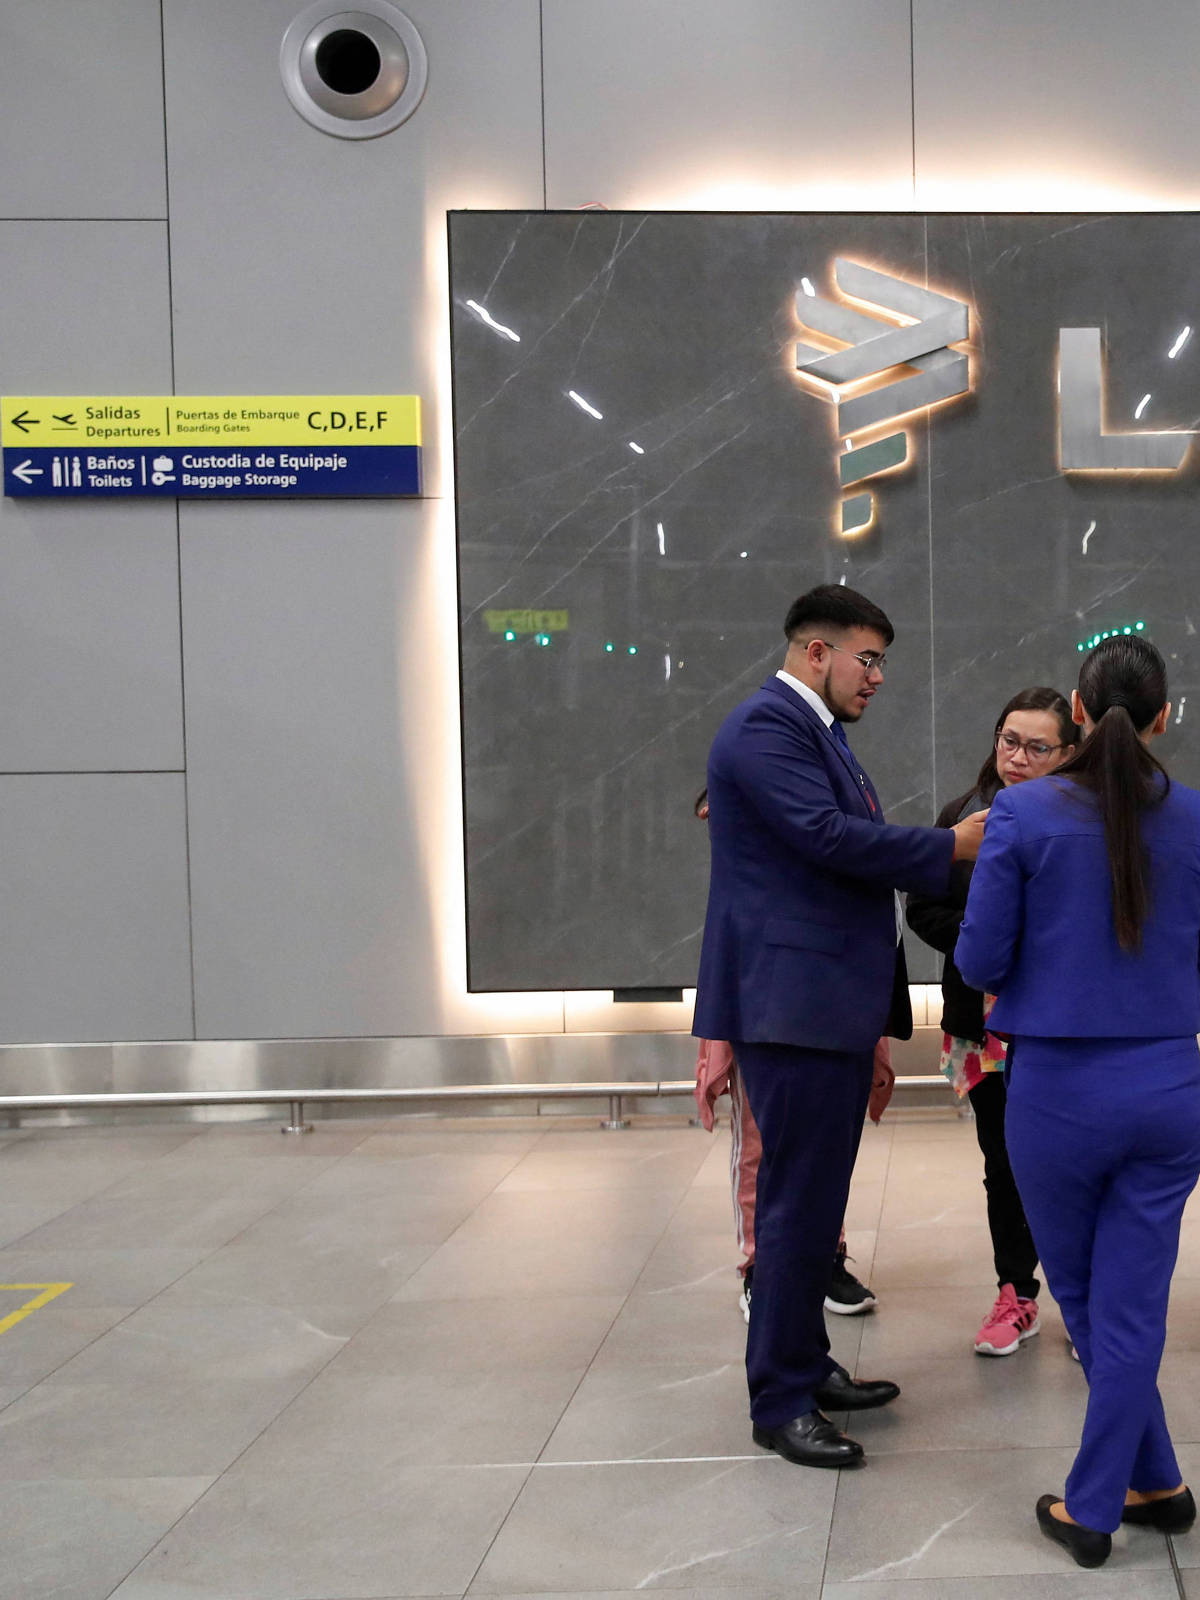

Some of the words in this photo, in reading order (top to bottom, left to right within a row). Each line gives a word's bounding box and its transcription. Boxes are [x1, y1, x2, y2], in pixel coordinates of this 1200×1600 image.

[86, 406, 141, 420] Salidas
[176, 410, 220, 420] Puertas
[223, 410, 237, 420] de
[241, 410, 300, 423] Embarque
[307, 411, 388, 432] C,D,E,F
[86, 426, 161, 439] Departures
[176, 424, 220, 434] Boarding
[223, 424, 251, 433] Gates
[87, 455, 136, 470] Baños
[182, 453, 251, 468] Custodia
[255, 453, 275, 468] de
[279, 454, 348, 471] Equipaje
[87, 474, 133, 487] Toilets
[182, 474, 241, 488] Baggage
[244, 473, 298, 488] Storage
